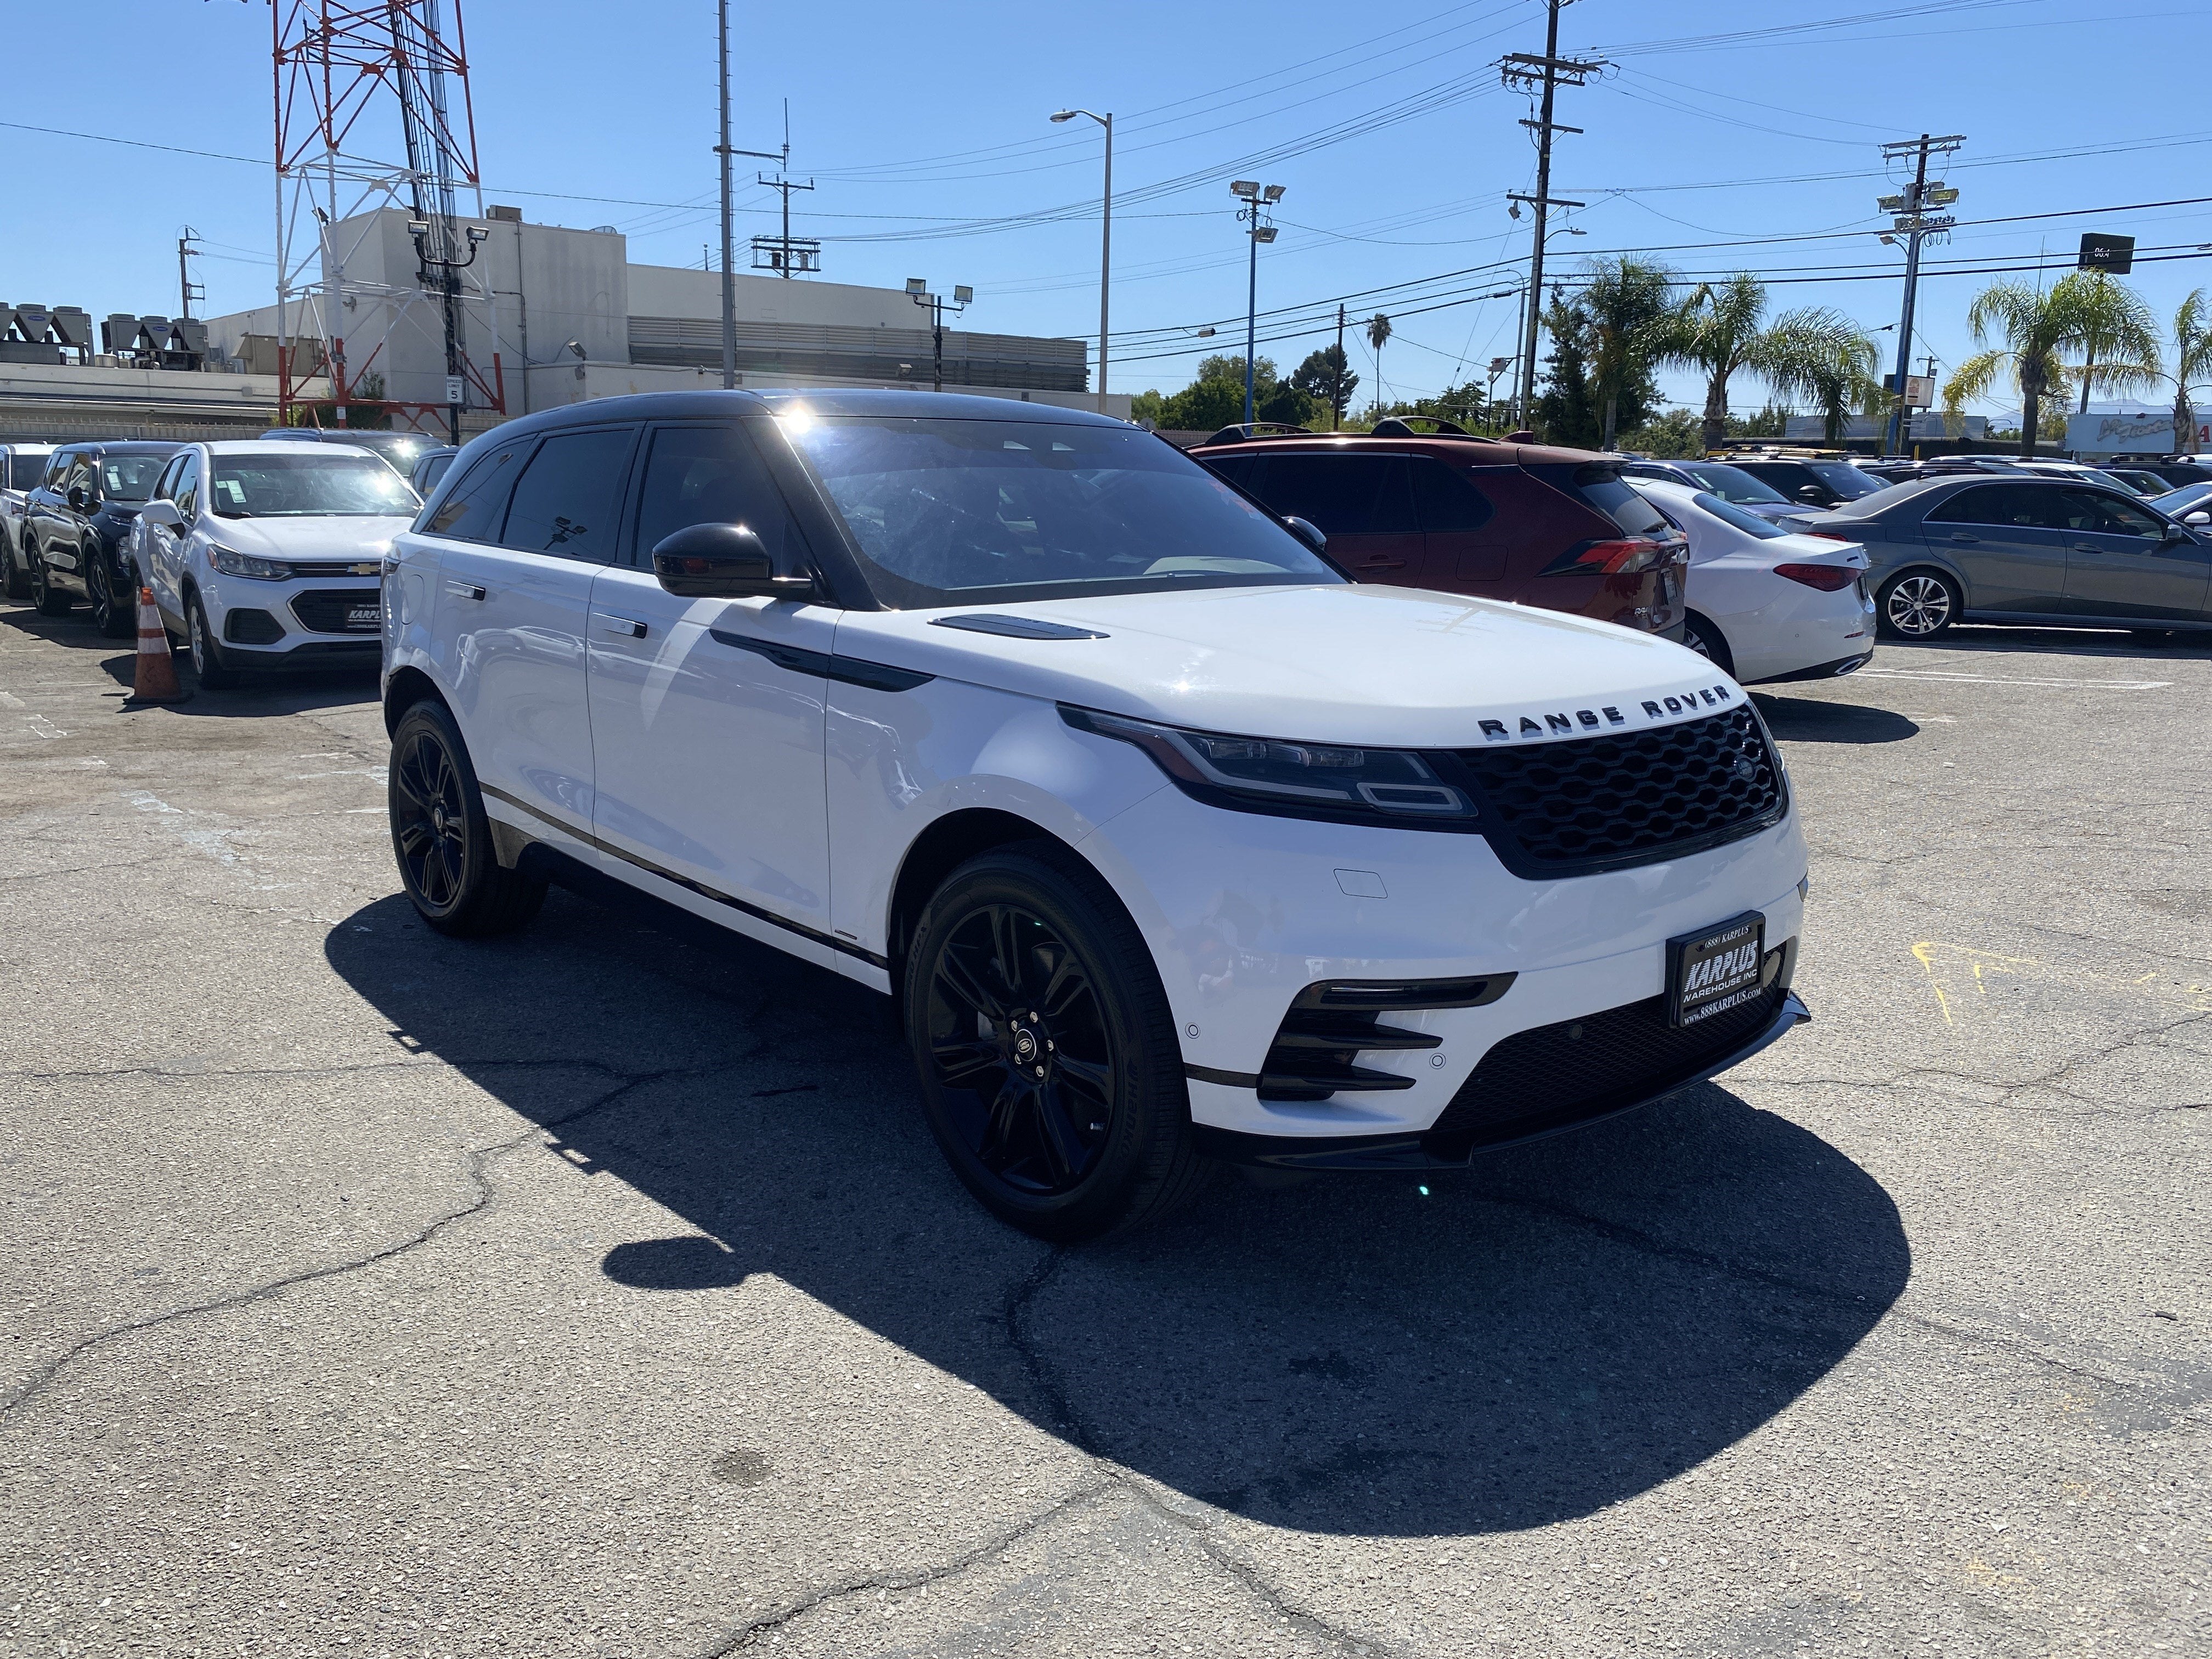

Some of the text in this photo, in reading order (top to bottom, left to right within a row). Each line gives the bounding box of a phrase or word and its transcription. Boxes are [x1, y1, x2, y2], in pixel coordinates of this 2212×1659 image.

[451, 390, 458, 399] 5
[348, 610, 380, 619] KARPL
[1477, 684, 1730, 735] RANGE ROVER
[1705, 925, 1750, 949] (888) KARPLUS
[1684, 940, 1758, 992] KARPLUS
[1743, 968, 1757, 981] INC
